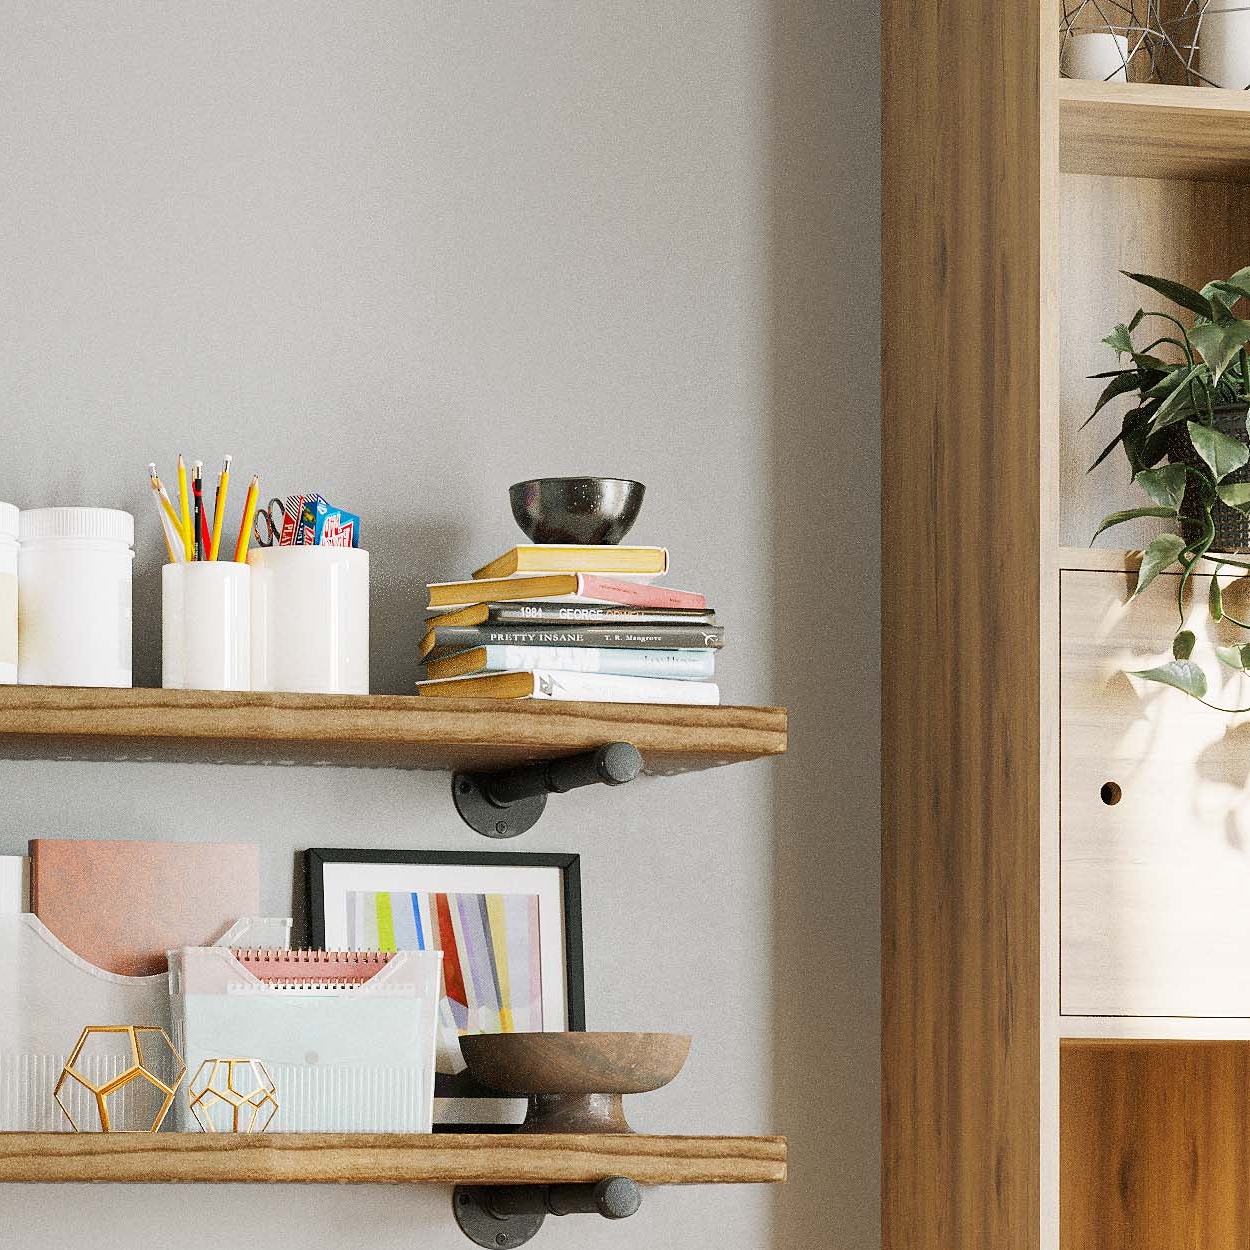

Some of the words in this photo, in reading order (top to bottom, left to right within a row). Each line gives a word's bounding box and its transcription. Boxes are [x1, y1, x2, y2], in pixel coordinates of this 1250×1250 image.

[520, 607, 543, 618] 1984
[558, 608, 604, 619] GEORGE
[490, 633, 536, 642] PRETTY
[539, 633, 584, 642] INSANE
[604, 634, 612, 642] T.
[614, 634, 623, 642] R.
[625, 634, 662, 643] Mangrove
